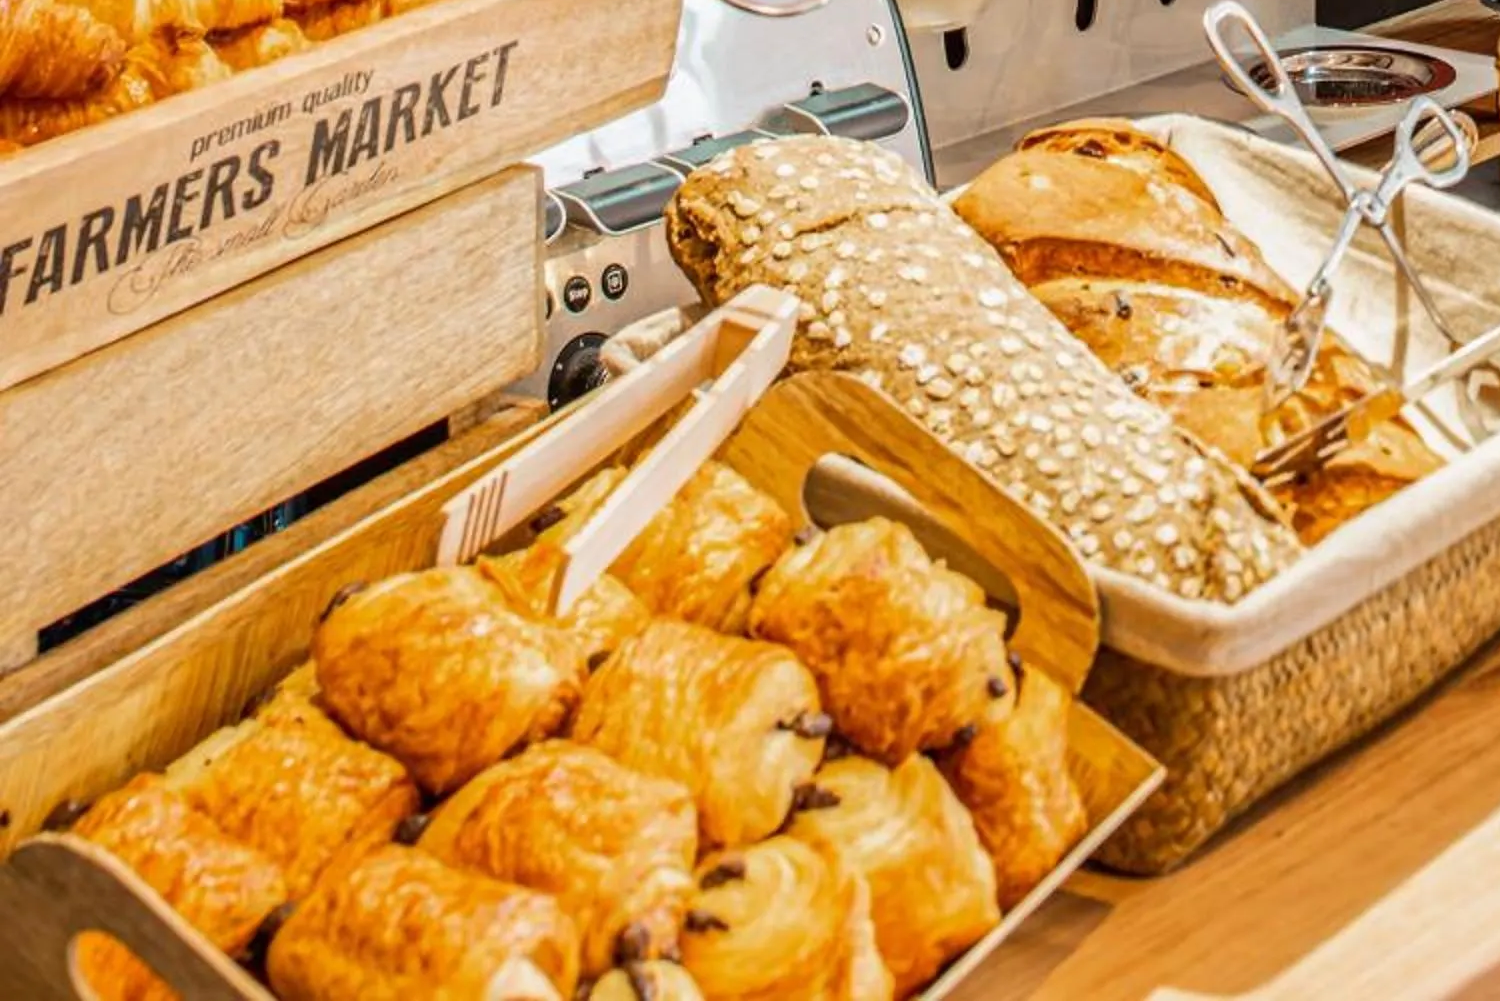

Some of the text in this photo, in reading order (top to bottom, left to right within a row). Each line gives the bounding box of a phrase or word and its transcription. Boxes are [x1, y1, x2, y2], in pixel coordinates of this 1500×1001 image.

[0, 39, 519, 317] FARMERS MARKET
[190, 69, 376, 164] premium quality
